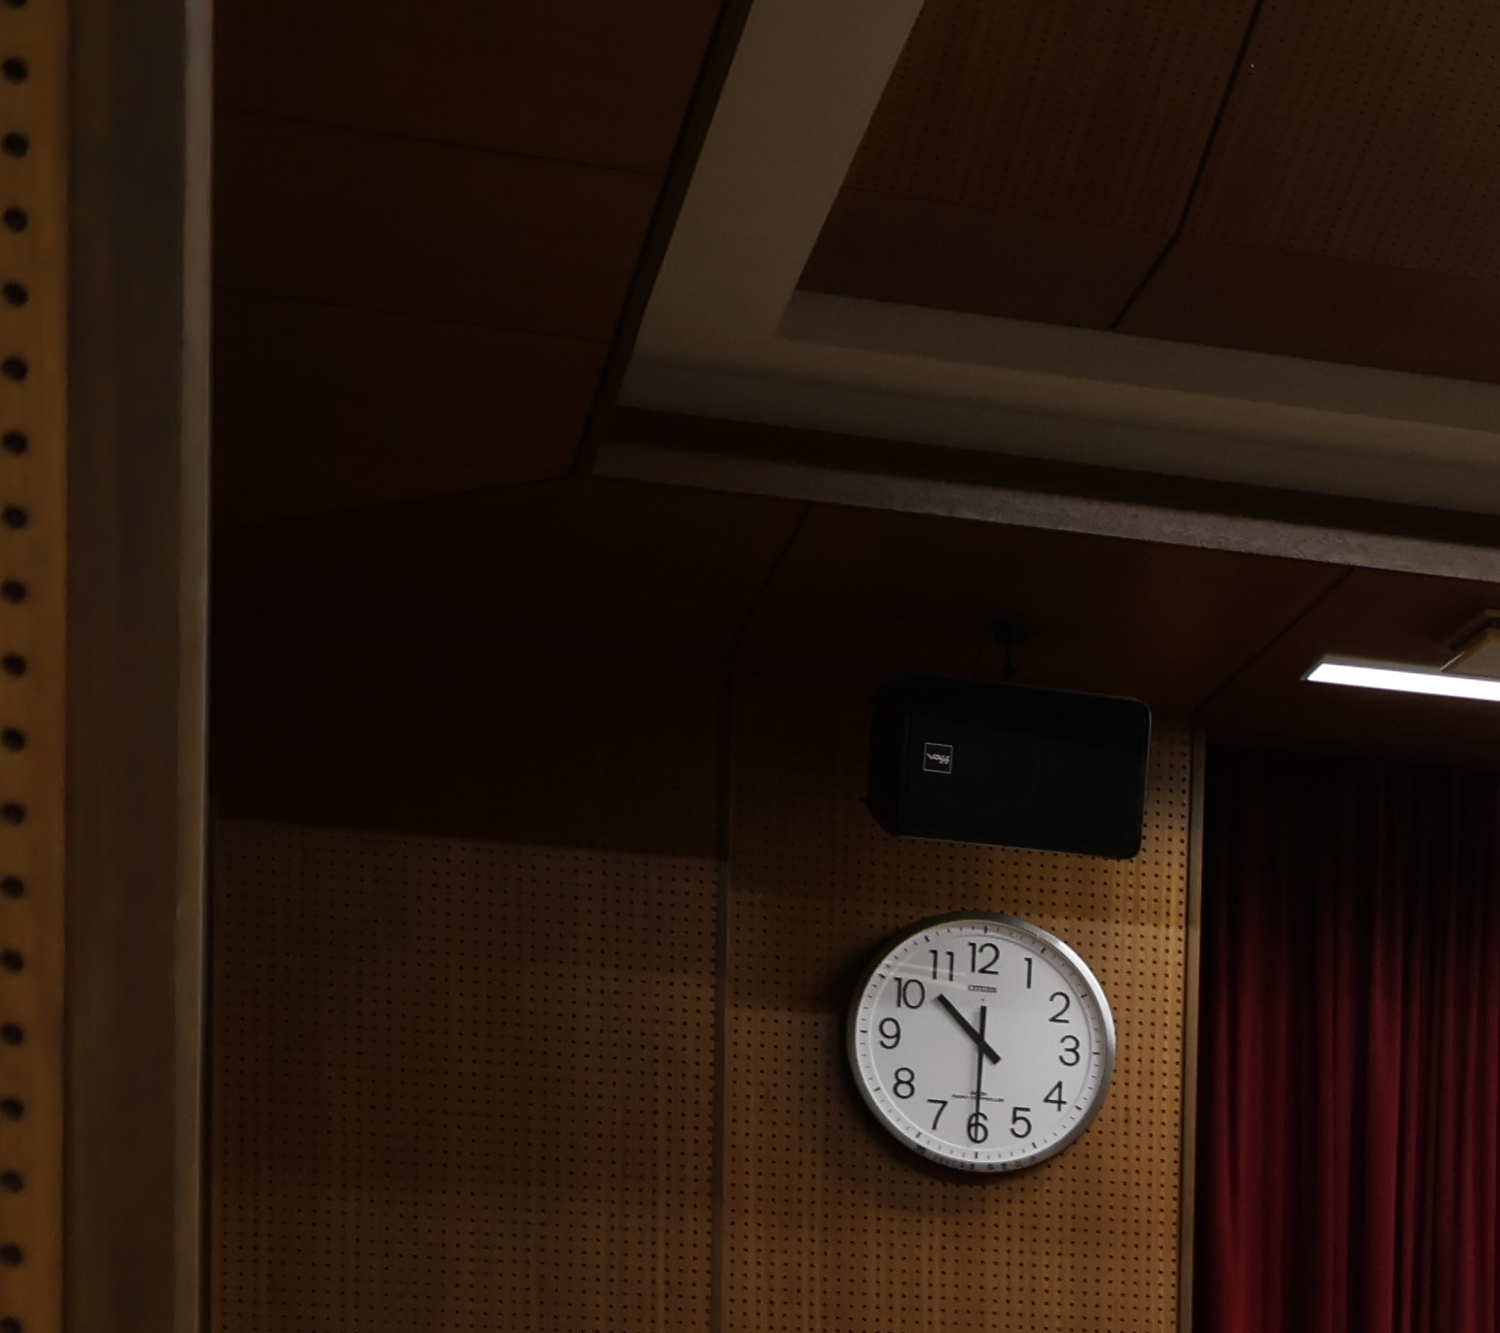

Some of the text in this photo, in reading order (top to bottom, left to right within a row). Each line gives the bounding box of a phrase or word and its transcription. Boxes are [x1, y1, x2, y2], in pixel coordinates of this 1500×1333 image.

[929, 949, 955, 982] 11
[968, 942, 1000, 975] 12
[1024, 957, 1033, 989] 1
[893, 977, 925, 1009] 10
[1048, 991, 1071, 1024] 2
[878, 1017, 901, 1050] 9
[1058, 1034, 1081, 1067] 3
[892, 1067, 916, 1100] 8
[1043, 1080, 1067, 1112] 4
[927, 1098, 948, 1131] 7
[966, 1112, 989, 1144] 6
[1009, 1107, 1032, 1138] 5
